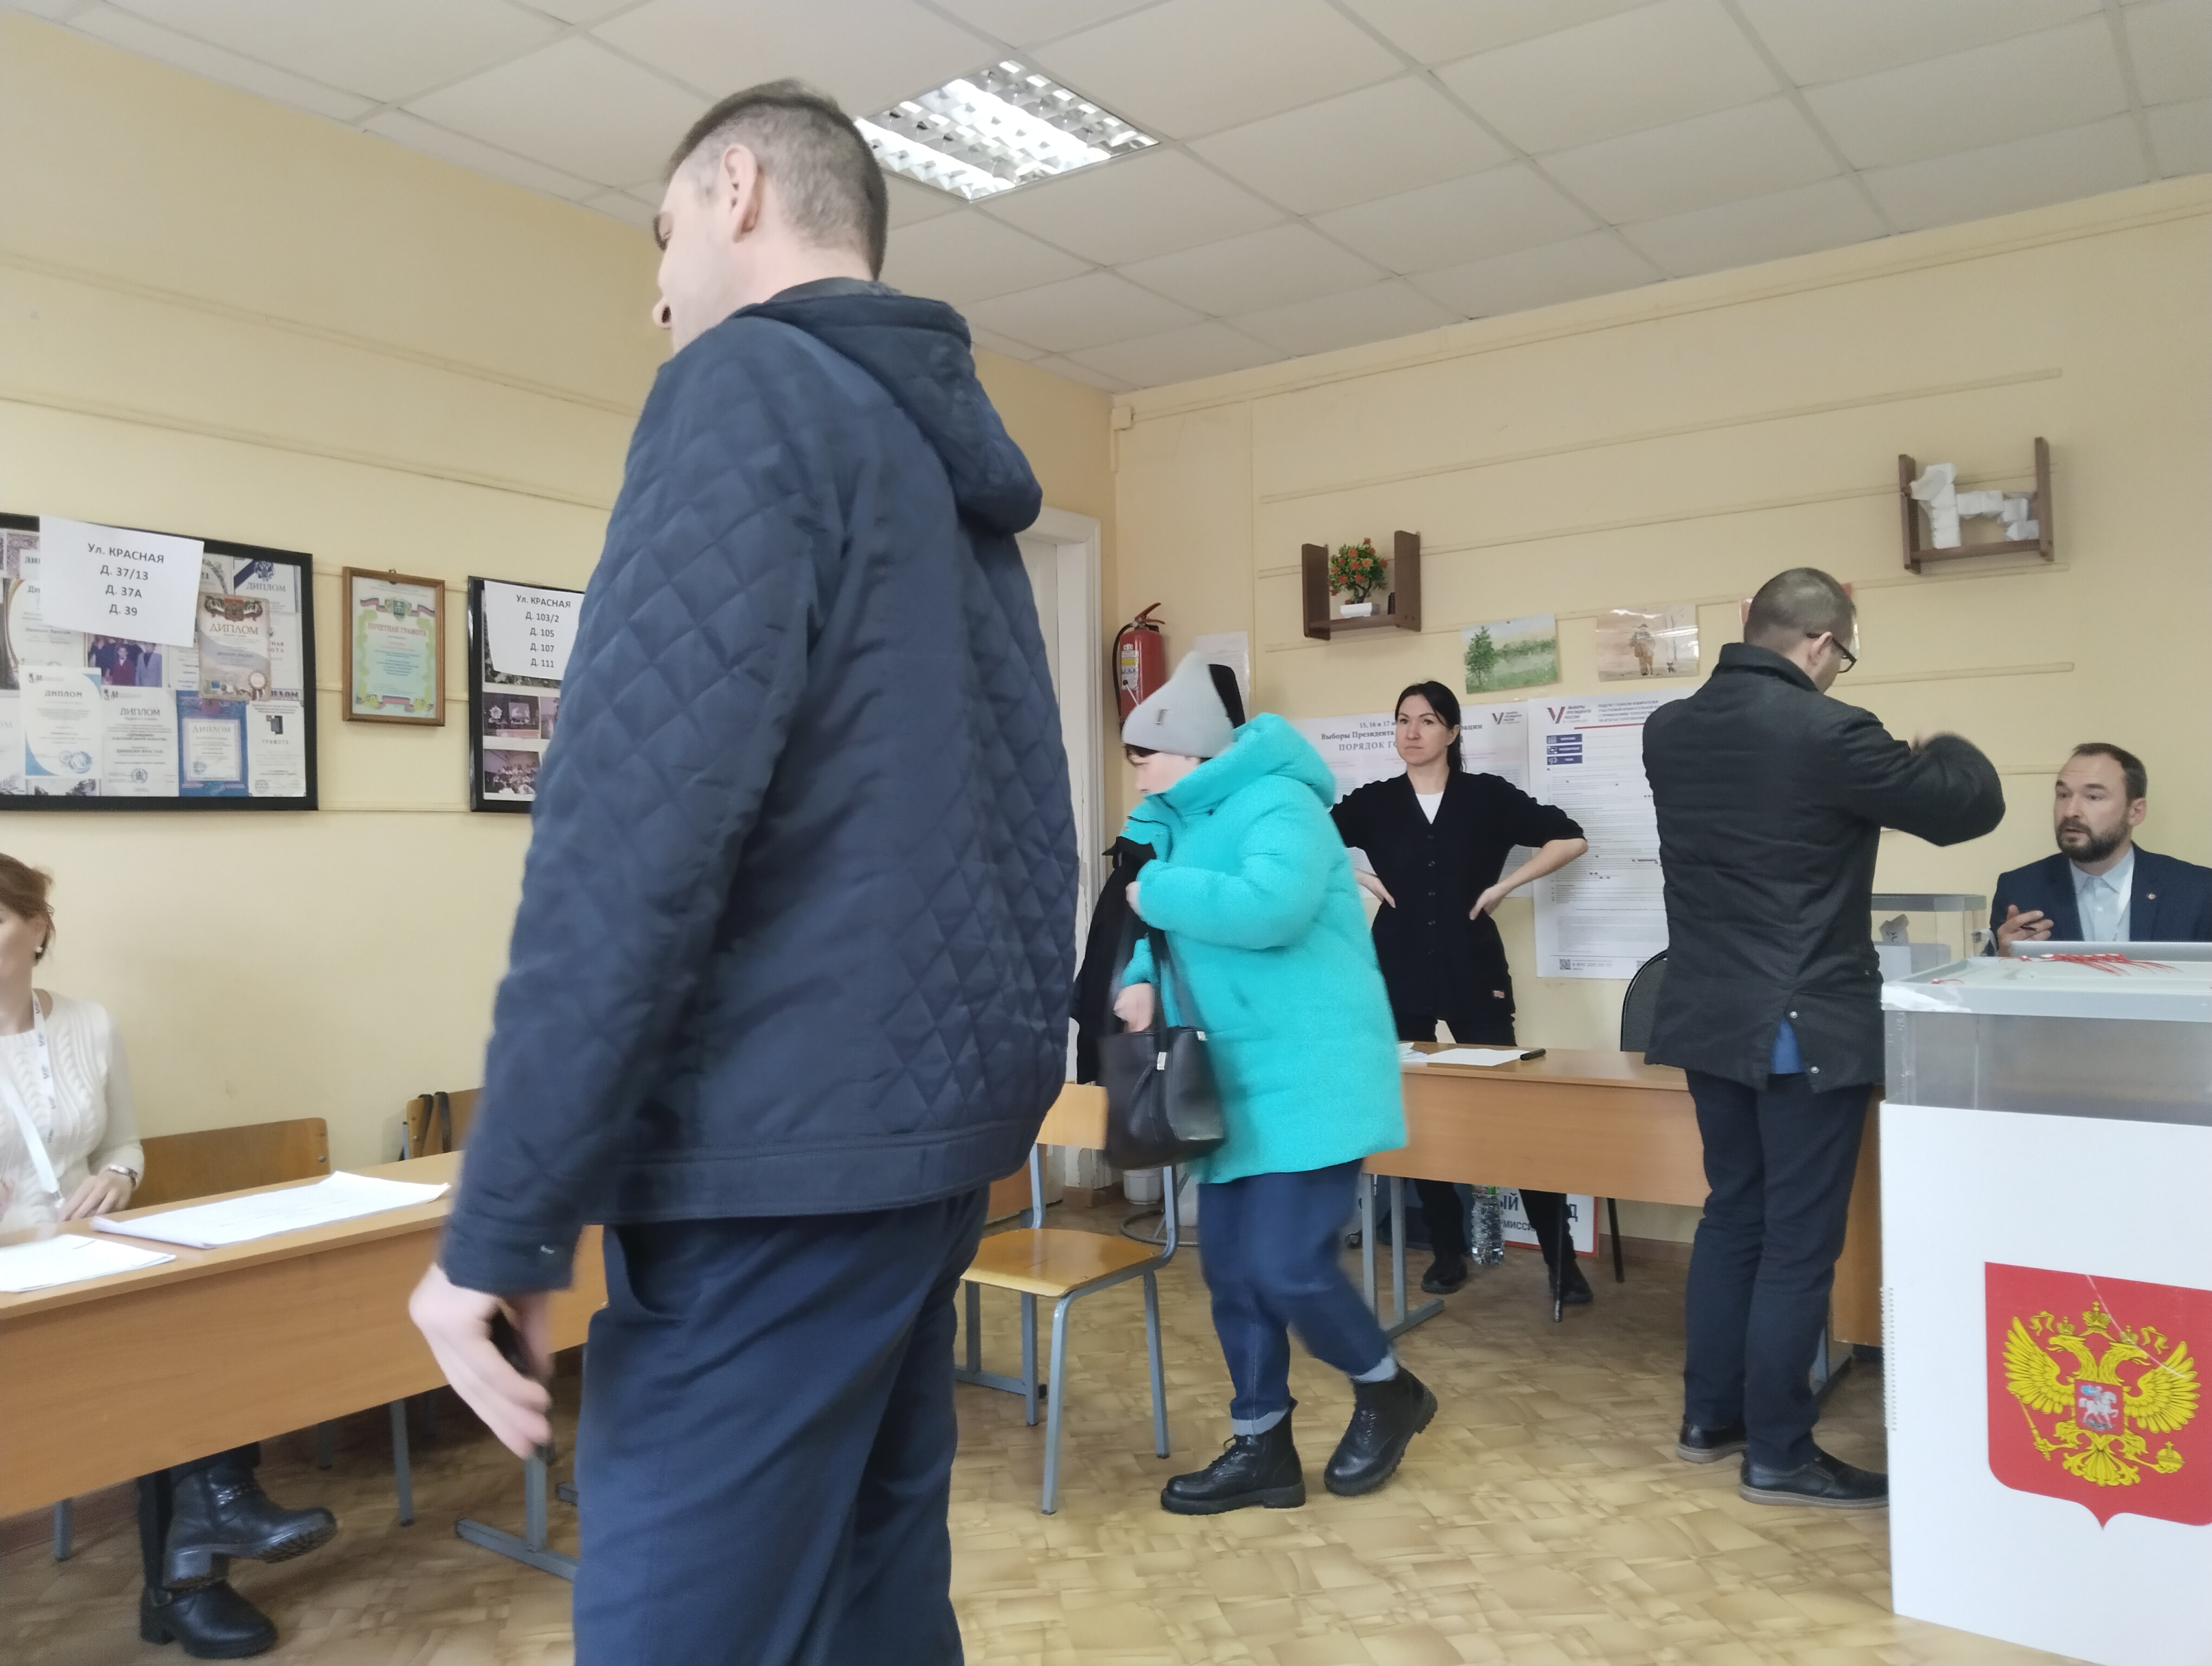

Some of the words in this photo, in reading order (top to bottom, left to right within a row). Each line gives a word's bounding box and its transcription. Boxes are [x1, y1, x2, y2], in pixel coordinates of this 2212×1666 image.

[88, 543, 105, 555] Ул.
[109, 547, 164, 564] КРАСНАЯ
[100, 565, 112, 576] Д.
[116, 567, 149, 580] 37/13
[105, 584, 117, 596] Д.
[121, 586, 142, 599] 37А
[246, 582, 286, 592] ДИПЛОМ
[516, 594, 529, 603] Ул.
[531, 597, 571, 608] КРАСНАЯ
[109, 604, 121, 616] Д.
[125, 606, 138, 616] 39
[525, 611, 534, 620] Д.
[536, 613, 560, 623] 103/2
[209, 623, 259, 635] ДИПЛОМ
[401, 627, 427, 637] ГРАМОТА
[530, 627, 538, 637] Д.
[541, 629, 555, 637] 105
[530, 643, 538, 652] Д.
[541, 644, 555, 652] 107
[531, 658, 539, 667] Д.
[541, 659, 555, 668] 111
[44, 690, 82, 698] ДИПЛОМ
[120, 708, 160, 716] ДИПЛОМ
[1352, 731, 1394, 740] Президента
[1339, 741, 1384, 751] ПОРЯДОК
